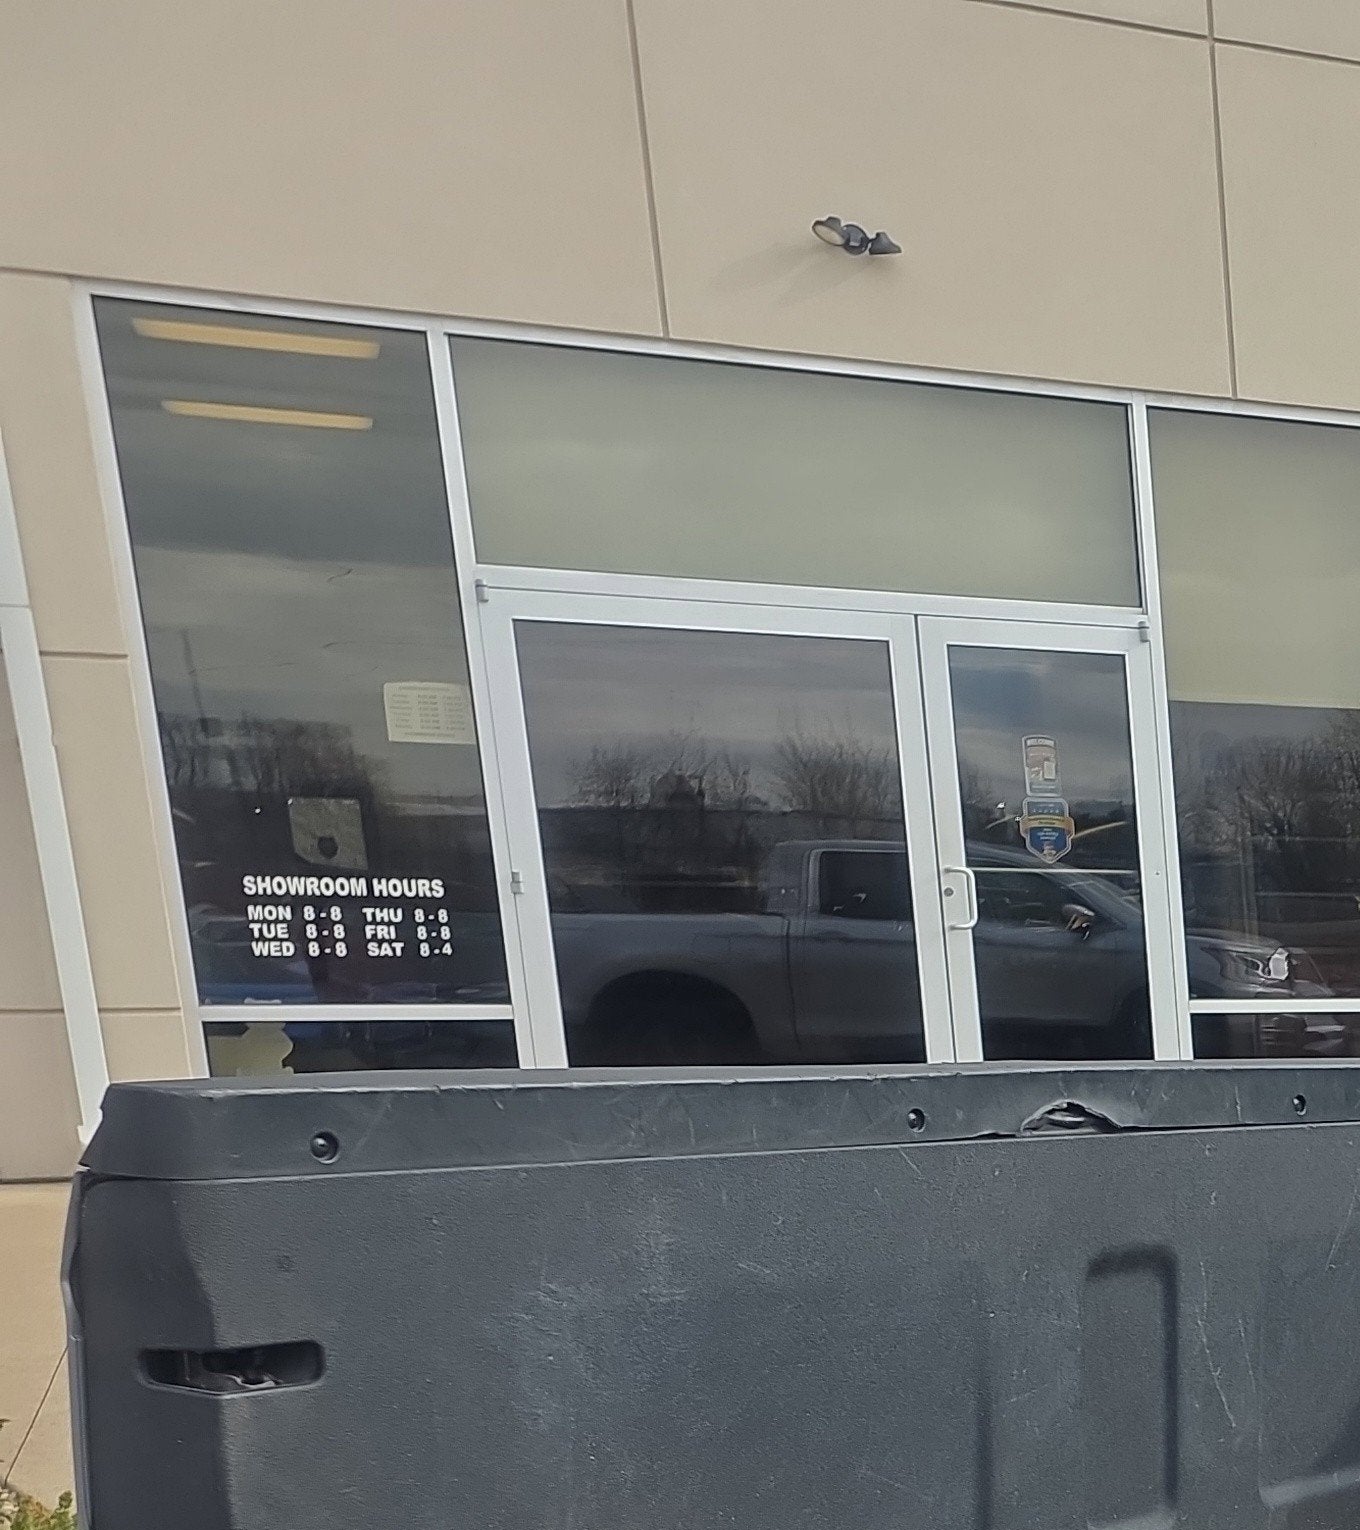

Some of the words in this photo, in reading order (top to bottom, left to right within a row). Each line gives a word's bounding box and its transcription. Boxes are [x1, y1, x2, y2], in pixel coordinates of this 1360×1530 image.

[242, 875, 368, 897] SHOWROOM
[372, 877, 445, 898] HOURS
[247, 905, 292, 921] MON
[361, 907, 403, 923] THU
[248, 923, 290, 939] TUE
[364, 924, 396, 940] FRI
[251, 941, 295, 957] WED
[366, 942, 404, 957] SAT
